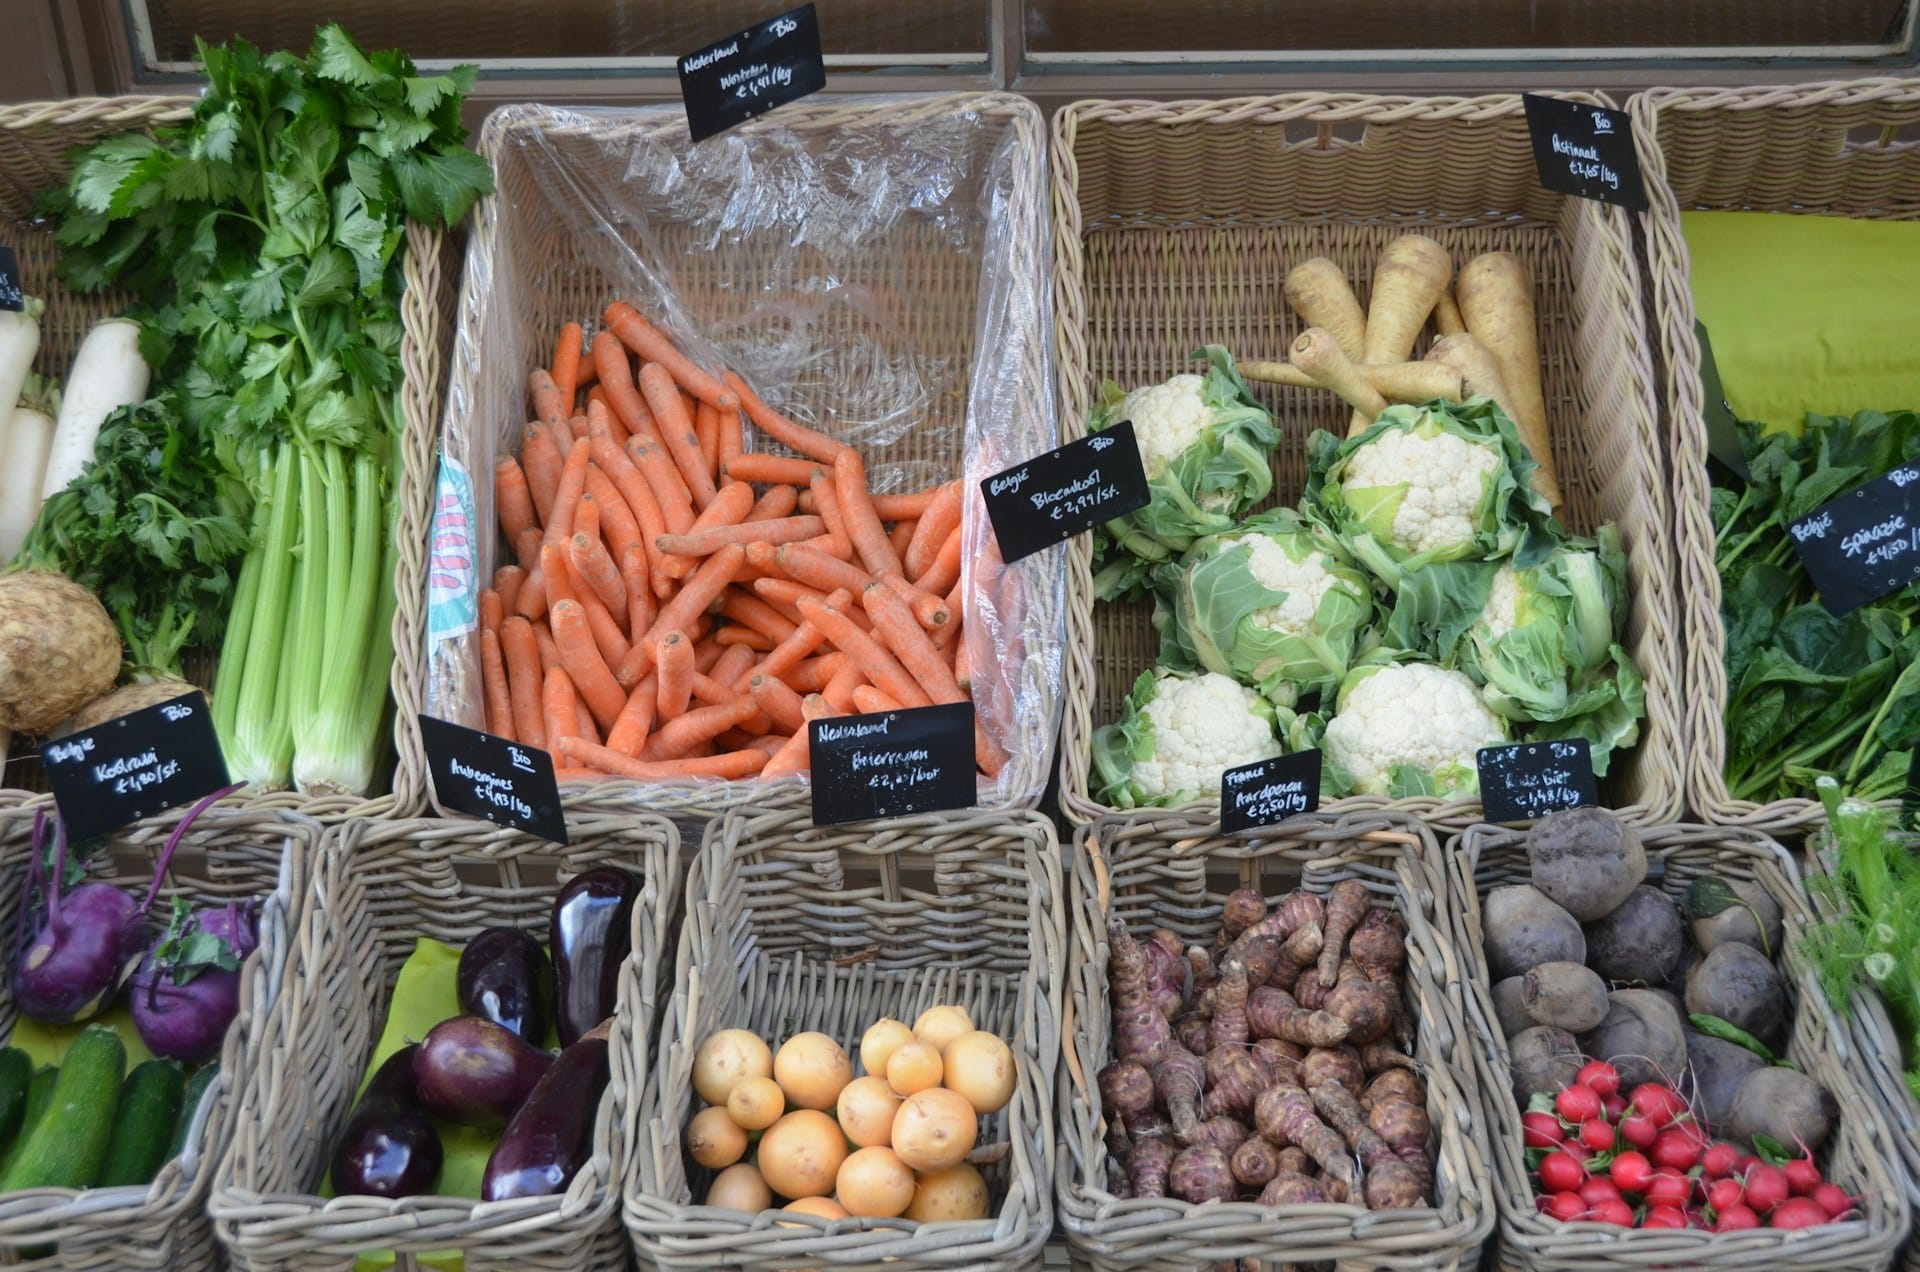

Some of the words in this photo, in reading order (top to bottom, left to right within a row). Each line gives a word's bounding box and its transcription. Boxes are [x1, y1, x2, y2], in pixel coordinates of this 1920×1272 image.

[769, 18, 798, 38] Bio
[684, 41, 739, 74] Nederland
[1591, 111, 1612, 130] Bio
[1088, 436, 1115, 453] Bio
[1887, 466, 1920, 488] Bio
[1030, 468, 1101, 511] Bloemkool
[1840, 513, 1906, 558] Spinazie
[161, 703, 193, 722] Bio
[818, 717, 889, 743] Nederland
[507, 746, 532, 765] Bio
[1550, 743, 1577, 758] Bio
[95, 746, 159, 782] Koolrabi
[451, 757, 514, 790] Aubergines
[1225, 766, 1265, 786] France
